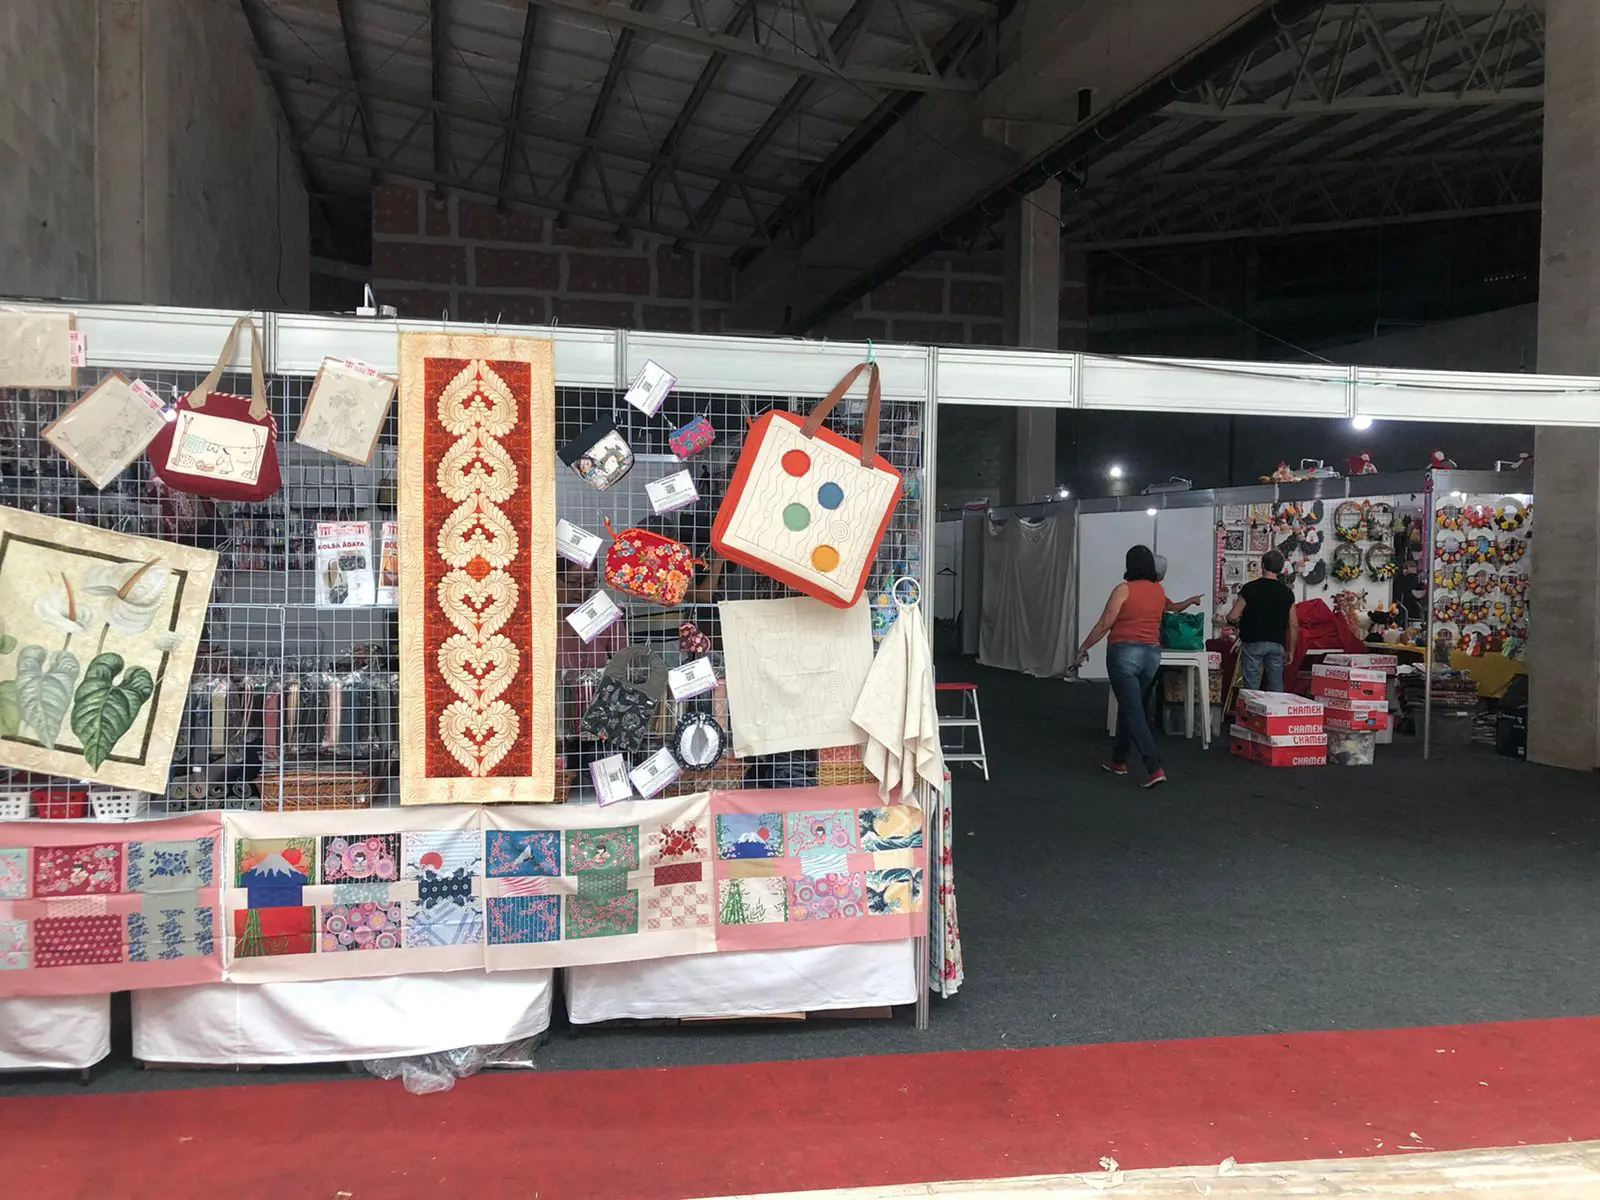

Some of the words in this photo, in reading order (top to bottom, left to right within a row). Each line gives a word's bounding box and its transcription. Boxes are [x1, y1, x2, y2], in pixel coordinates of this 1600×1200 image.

[1287, 705, 1322, 716] CHAMEX
[1288, 724, 1323, 734] CHAMEX
[1293, 736, 1327, 745] CHAMEX
[1292, 756, 1327, 766] CHAMEX
